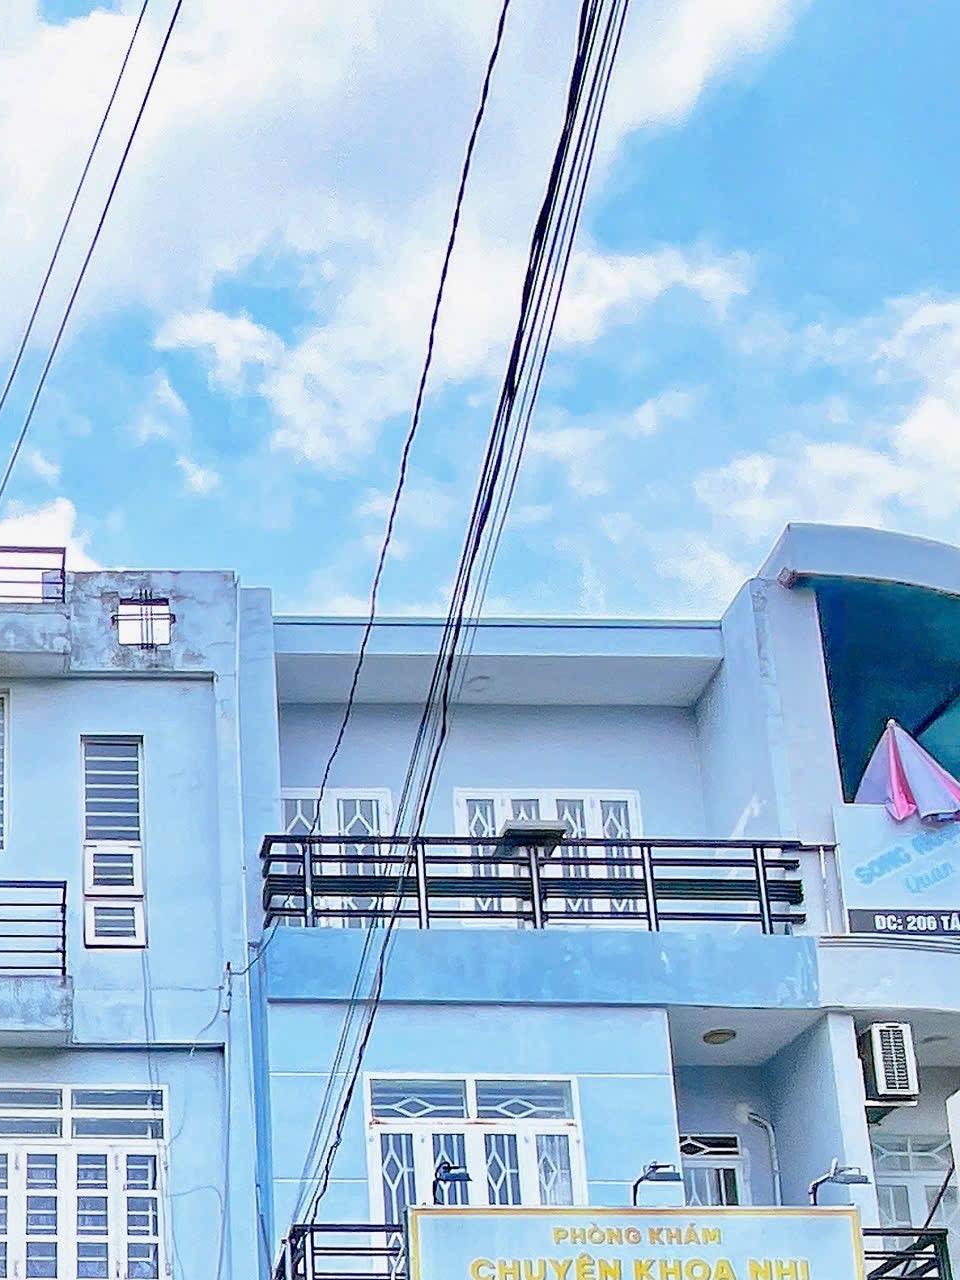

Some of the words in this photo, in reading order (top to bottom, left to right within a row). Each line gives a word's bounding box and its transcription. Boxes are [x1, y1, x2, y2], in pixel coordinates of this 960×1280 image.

[906, 915, 938, 931] 206
[552, 1222, 640, 1245] PHÒNG
[648, 1222, 722, 1245] KHÁM
